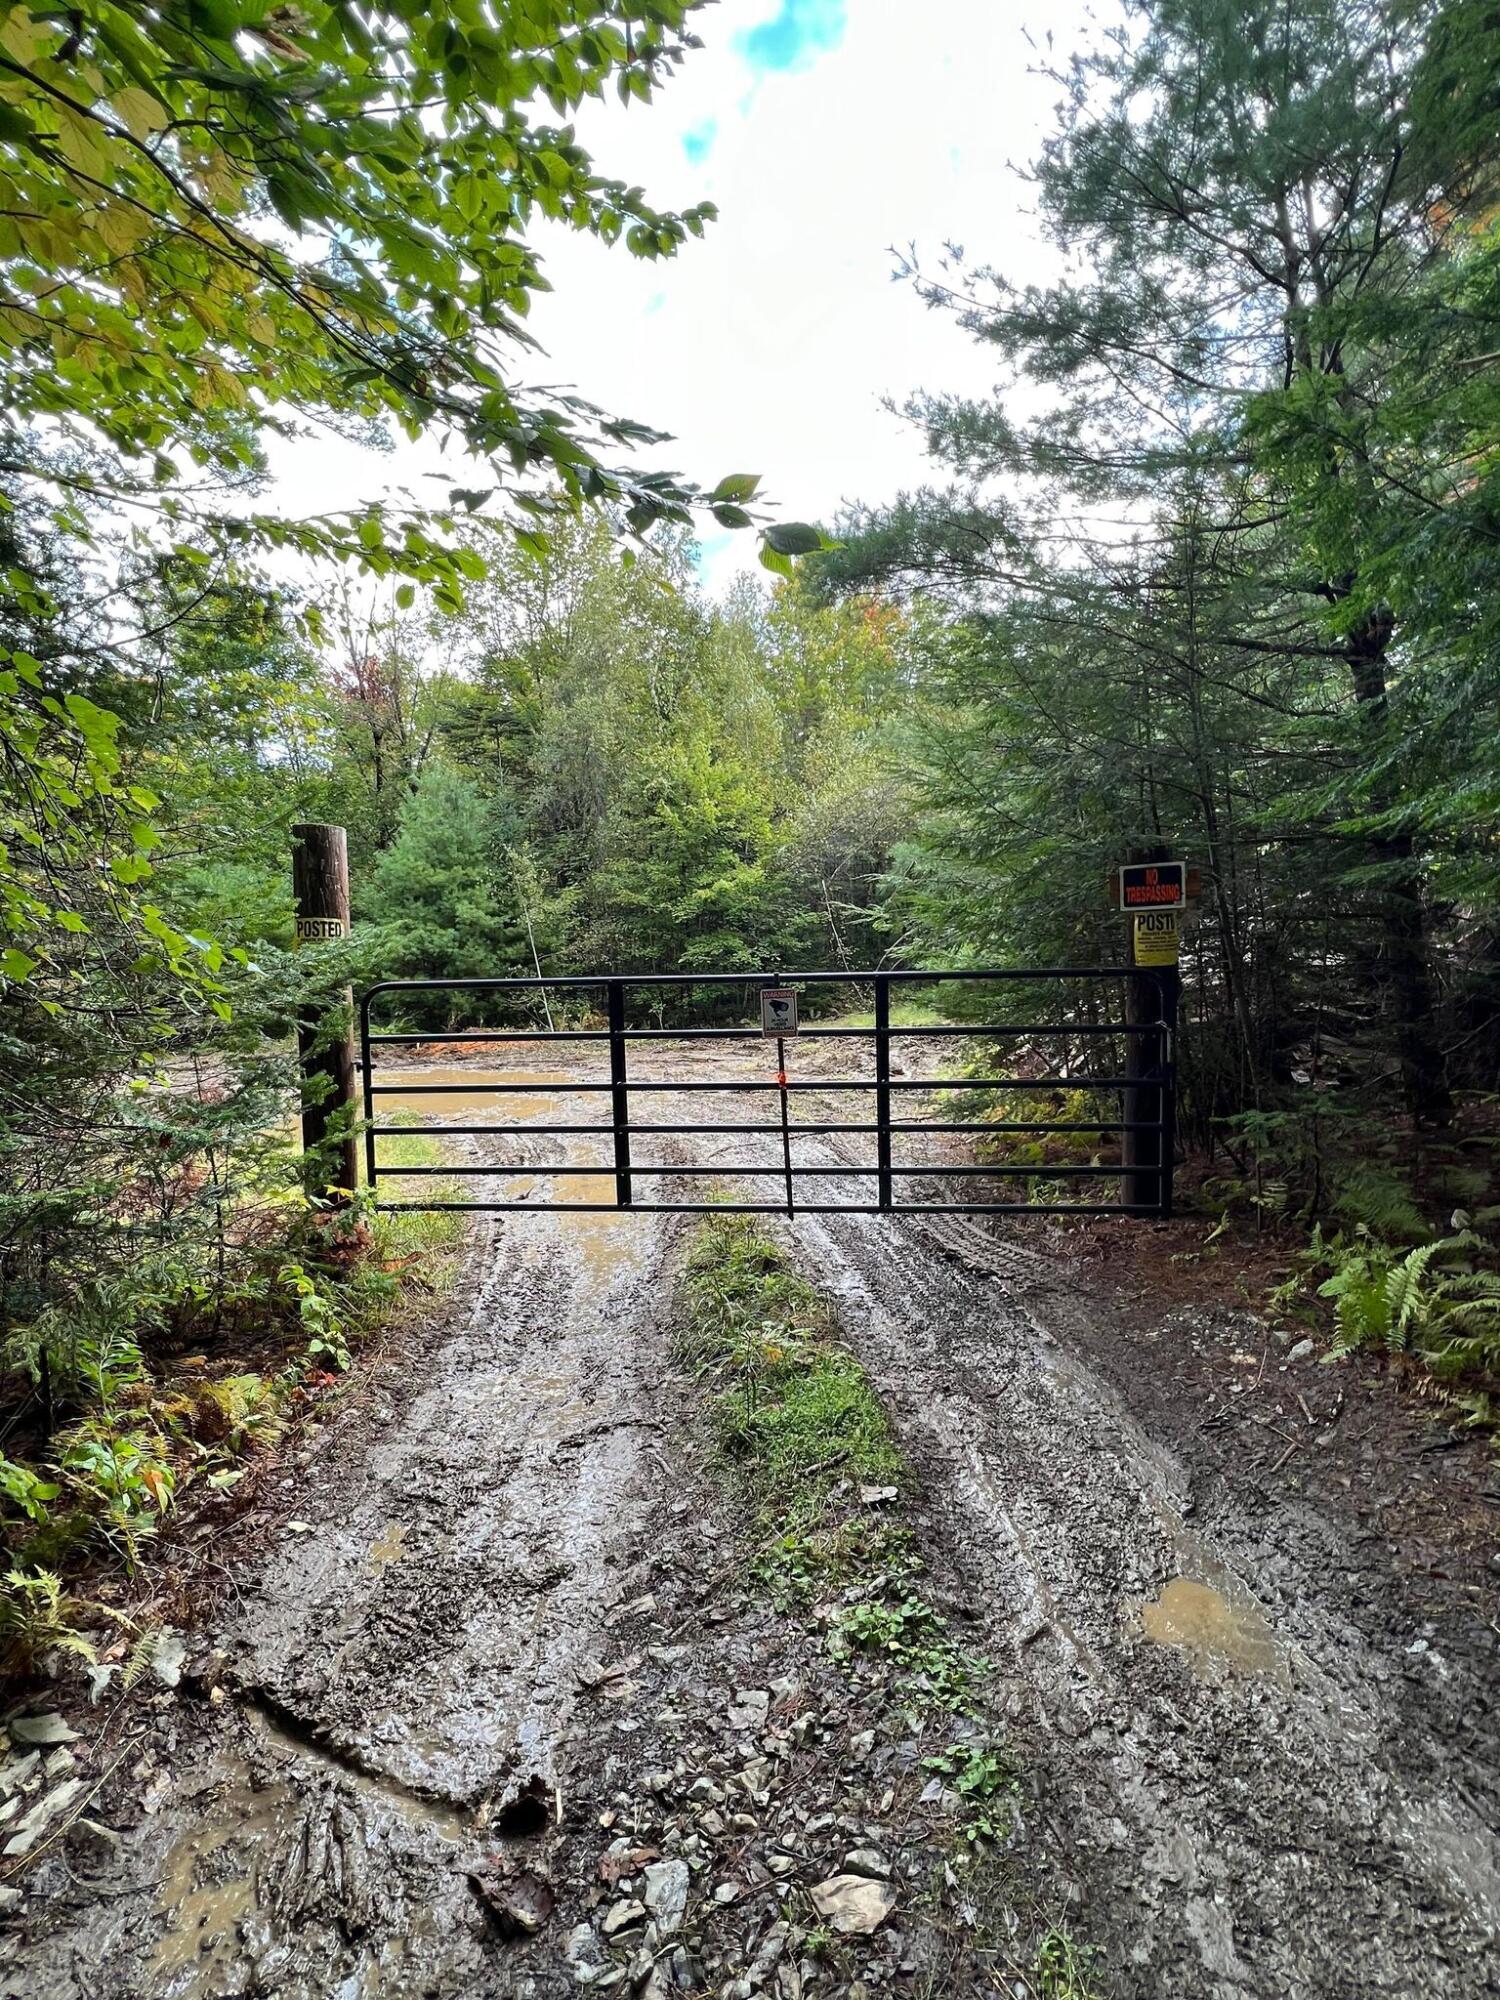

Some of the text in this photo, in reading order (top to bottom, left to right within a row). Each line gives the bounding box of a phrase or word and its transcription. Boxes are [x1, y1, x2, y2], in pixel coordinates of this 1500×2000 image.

[1145, 869, 1158, 885] NO
[1125, 883, 1180, 903] TRESPASSING
[297, 920, 341, 938] POSTED
